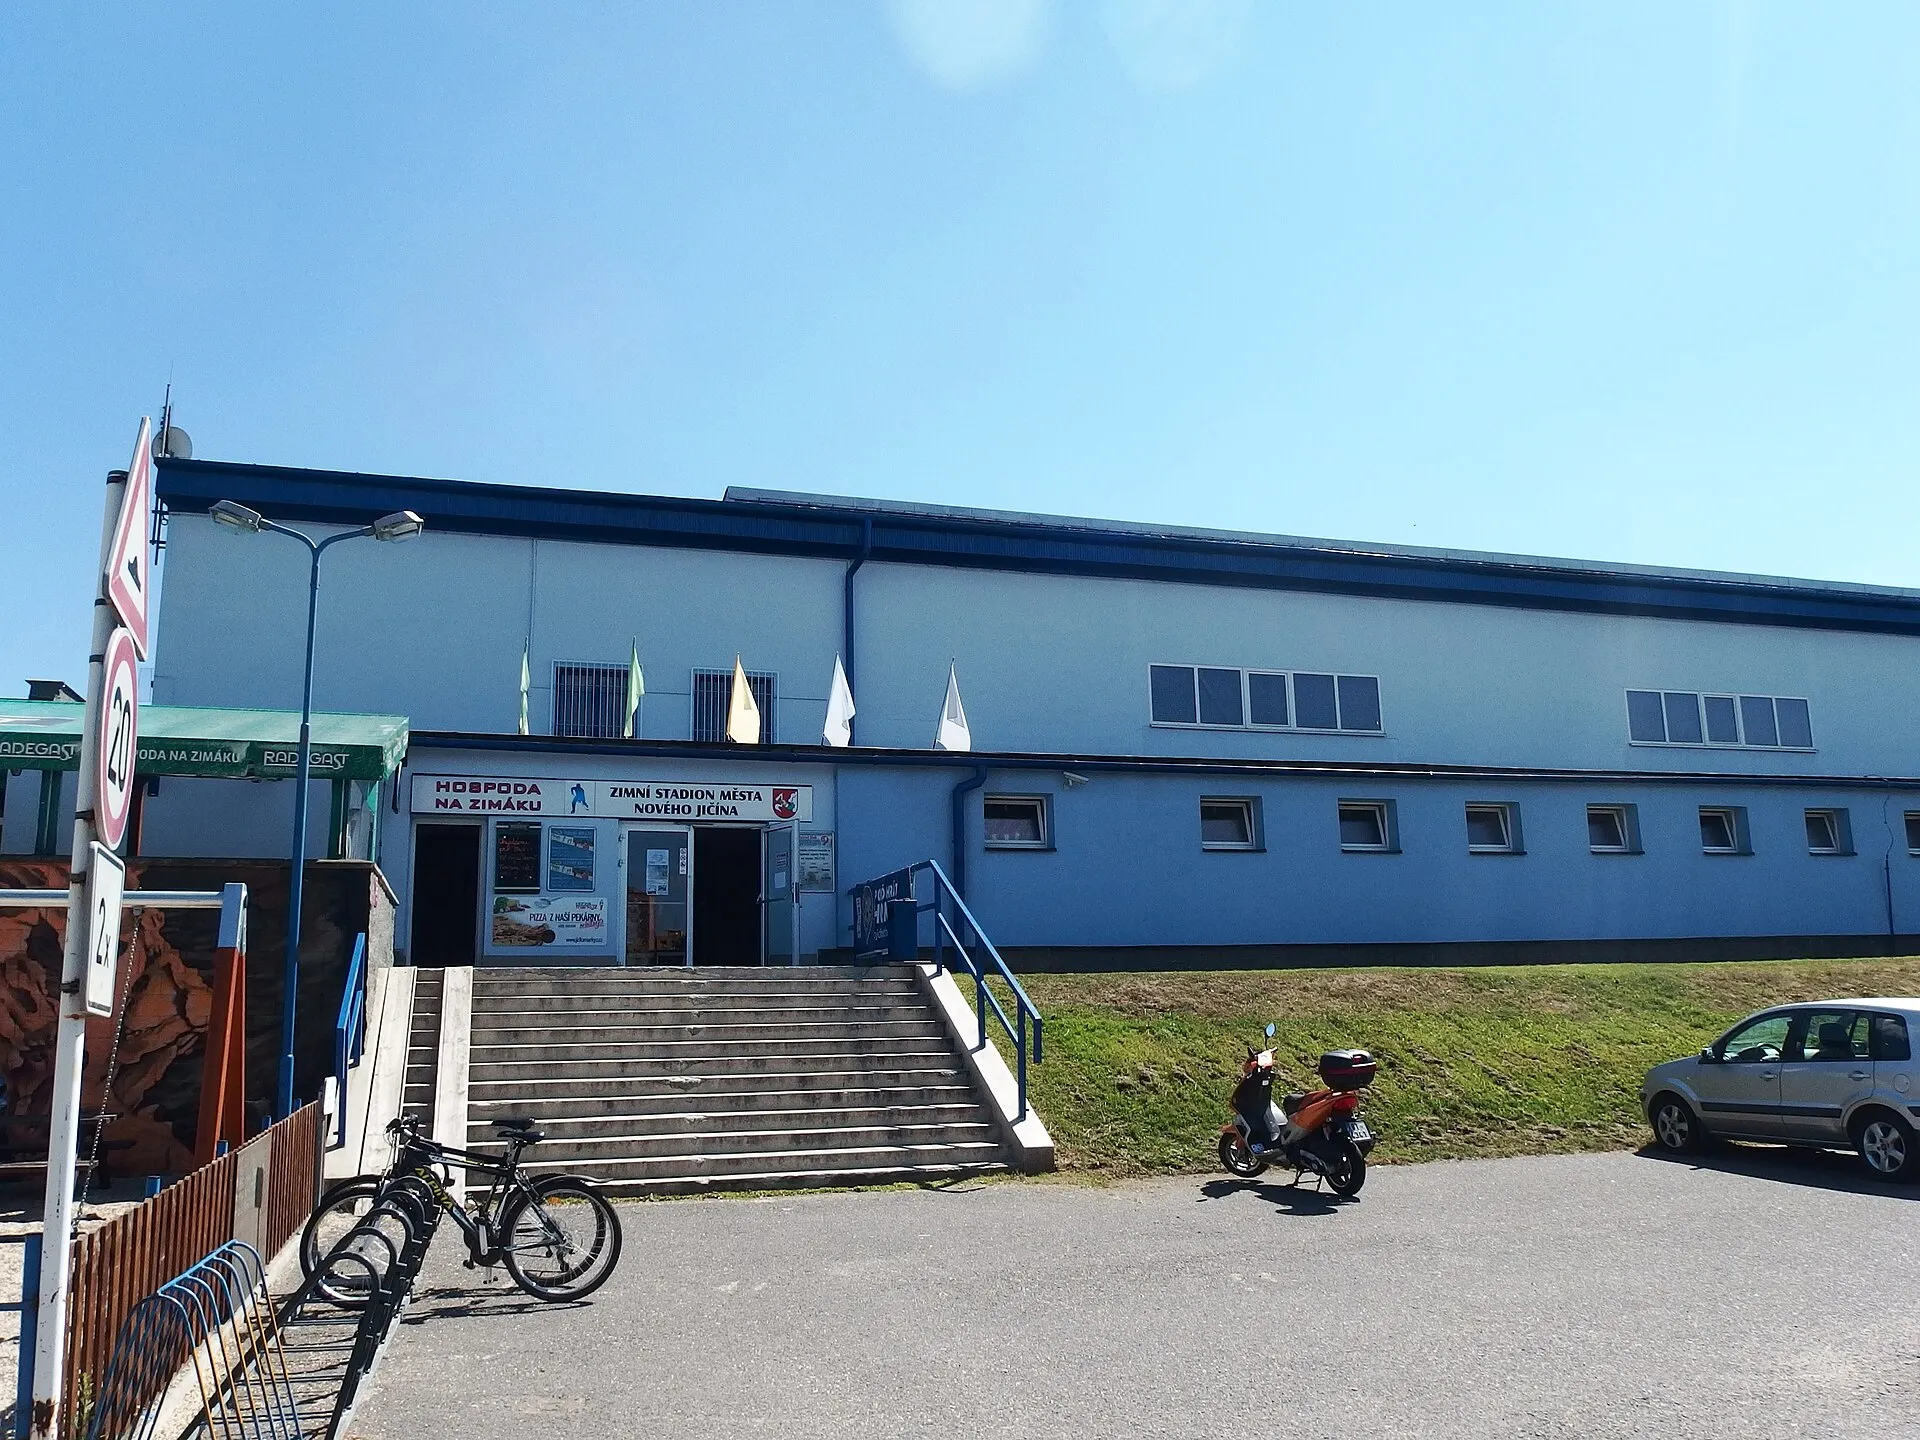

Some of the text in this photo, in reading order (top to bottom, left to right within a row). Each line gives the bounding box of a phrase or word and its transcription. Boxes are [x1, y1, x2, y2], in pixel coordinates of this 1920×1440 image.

[108, 686, 131, 792] 20
[0, 741, 78, 761] ADEGAST
[169, 750, 187, 761] NA
[190, 749, 240, 763] ZIMÁKU
[263, 751, 350, 770] RADGAST
[435, 781, 541, 795] HOSPODA
[610, 785, 762, 802] ZIMNÍ STADION MĚSTA
[435, 797, 541, 812] NA ZIMÁKU
[634, 801, 738, 817] NOVÉHO JIČÍNA
[529, 913, 547, 921] PIZZA
[549, 913, 554, 921] Z
[555, 911, 570, 922] NAŠÍ
